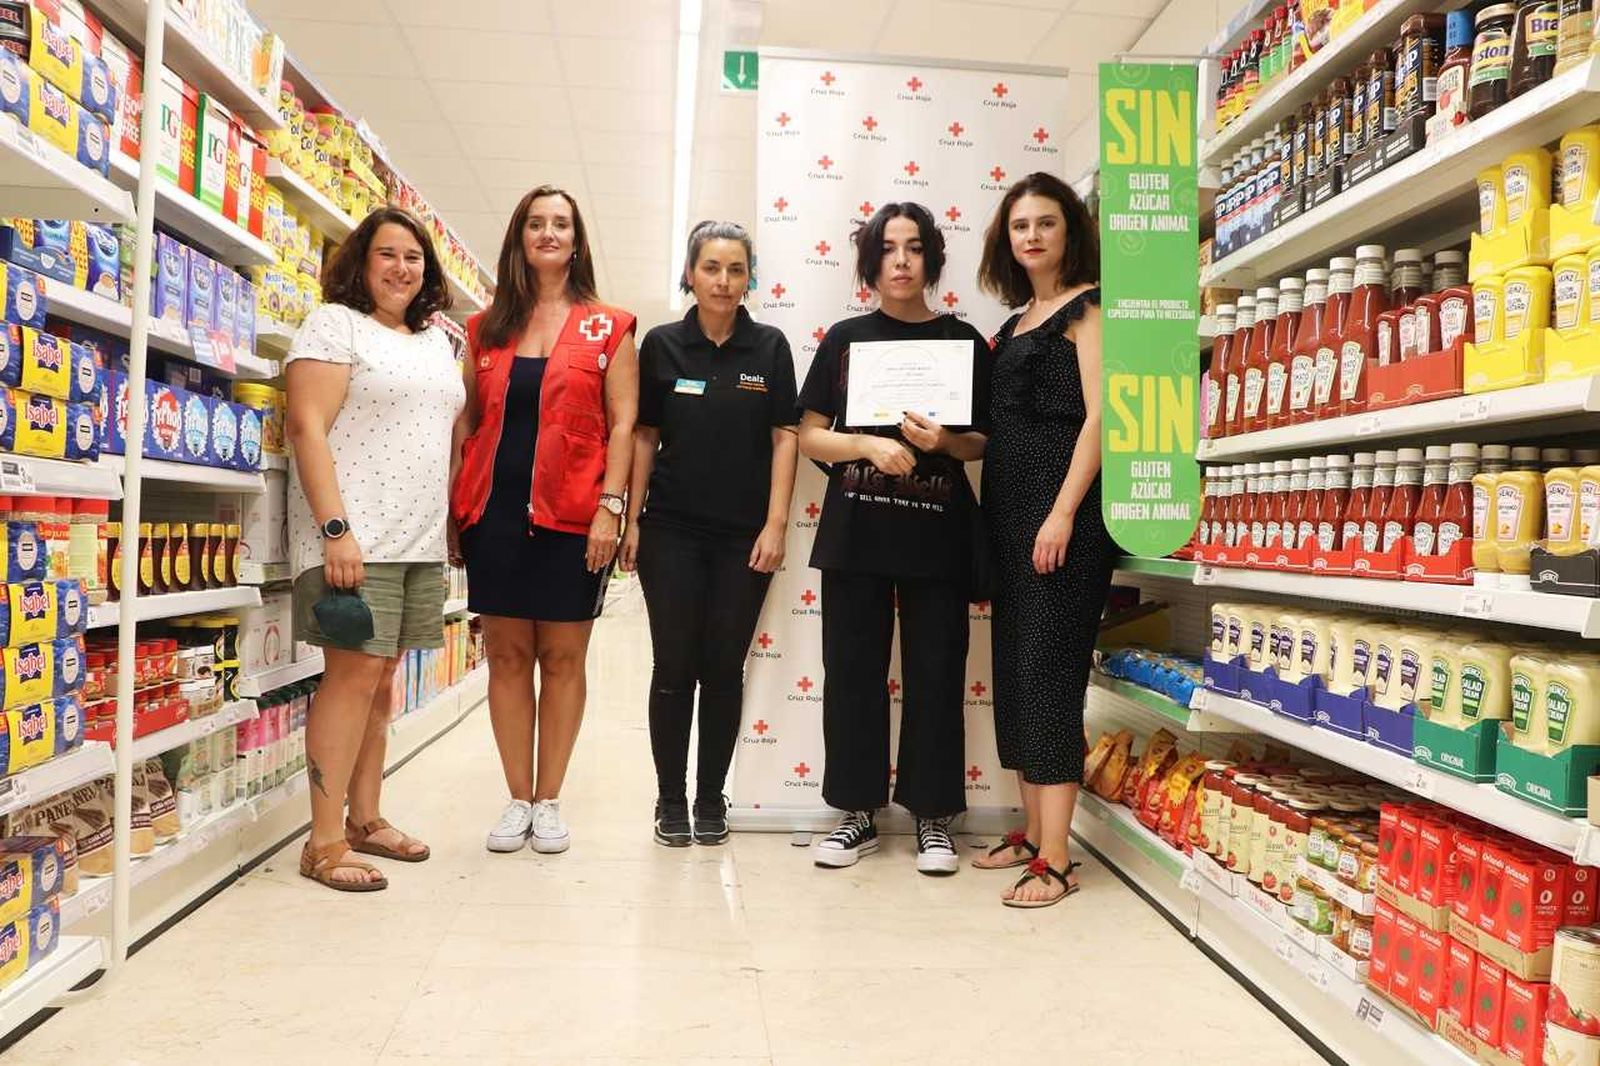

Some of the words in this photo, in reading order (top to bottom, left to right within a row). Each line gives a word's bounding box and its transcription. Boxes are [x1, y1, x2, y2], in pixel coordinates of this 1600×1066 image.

[1531, 17, 1558, 34] Bra
[1001, 101, 1017, 109] Roja
[161, 104, 180, 139] PG
[1105, 88, 1191, 167] SIN
[208, 133, 226, 165] PG
[1129, 173, 1170, 190] GLUTEN
[1129, 190, 1170, 211] AZÚCAR
[1109, 214, 1148, 231] ORIGEN
[1150, 214, 1190, 232] ANIMAL
[33, 340, 64, 368] Isabel
[740, 373, 765, 384] Dealz
[24, 403, 58, 428] Isabel
[1108, 374, 1194, 453] SIN
[1131, 461, 1171, 478] GLUTEN
[1131, 478, 1171, 499] AZÚCAR
[1111, 503, 1150, 521] ORIGEN
[1152, 503, 1191, 521] ANIMAL
[796, 520, 812, 528] Cruz
[1541, 572, 1558, 583] HEINZ
[20, 591, 51, 617] Isabel
[14, 652, 46, 678] Isabel
[18, 713, 48, 738] Isabel
[1440, 752, 1464, 769] ORIGINAL
[1526, 782, 1552, 800] ORIGINAL
[1482, 852, 1505, 869] Orlando
[1504, 864, 1529, 883] Orlando
[1507, 978, 1533, 1000] Orlando
